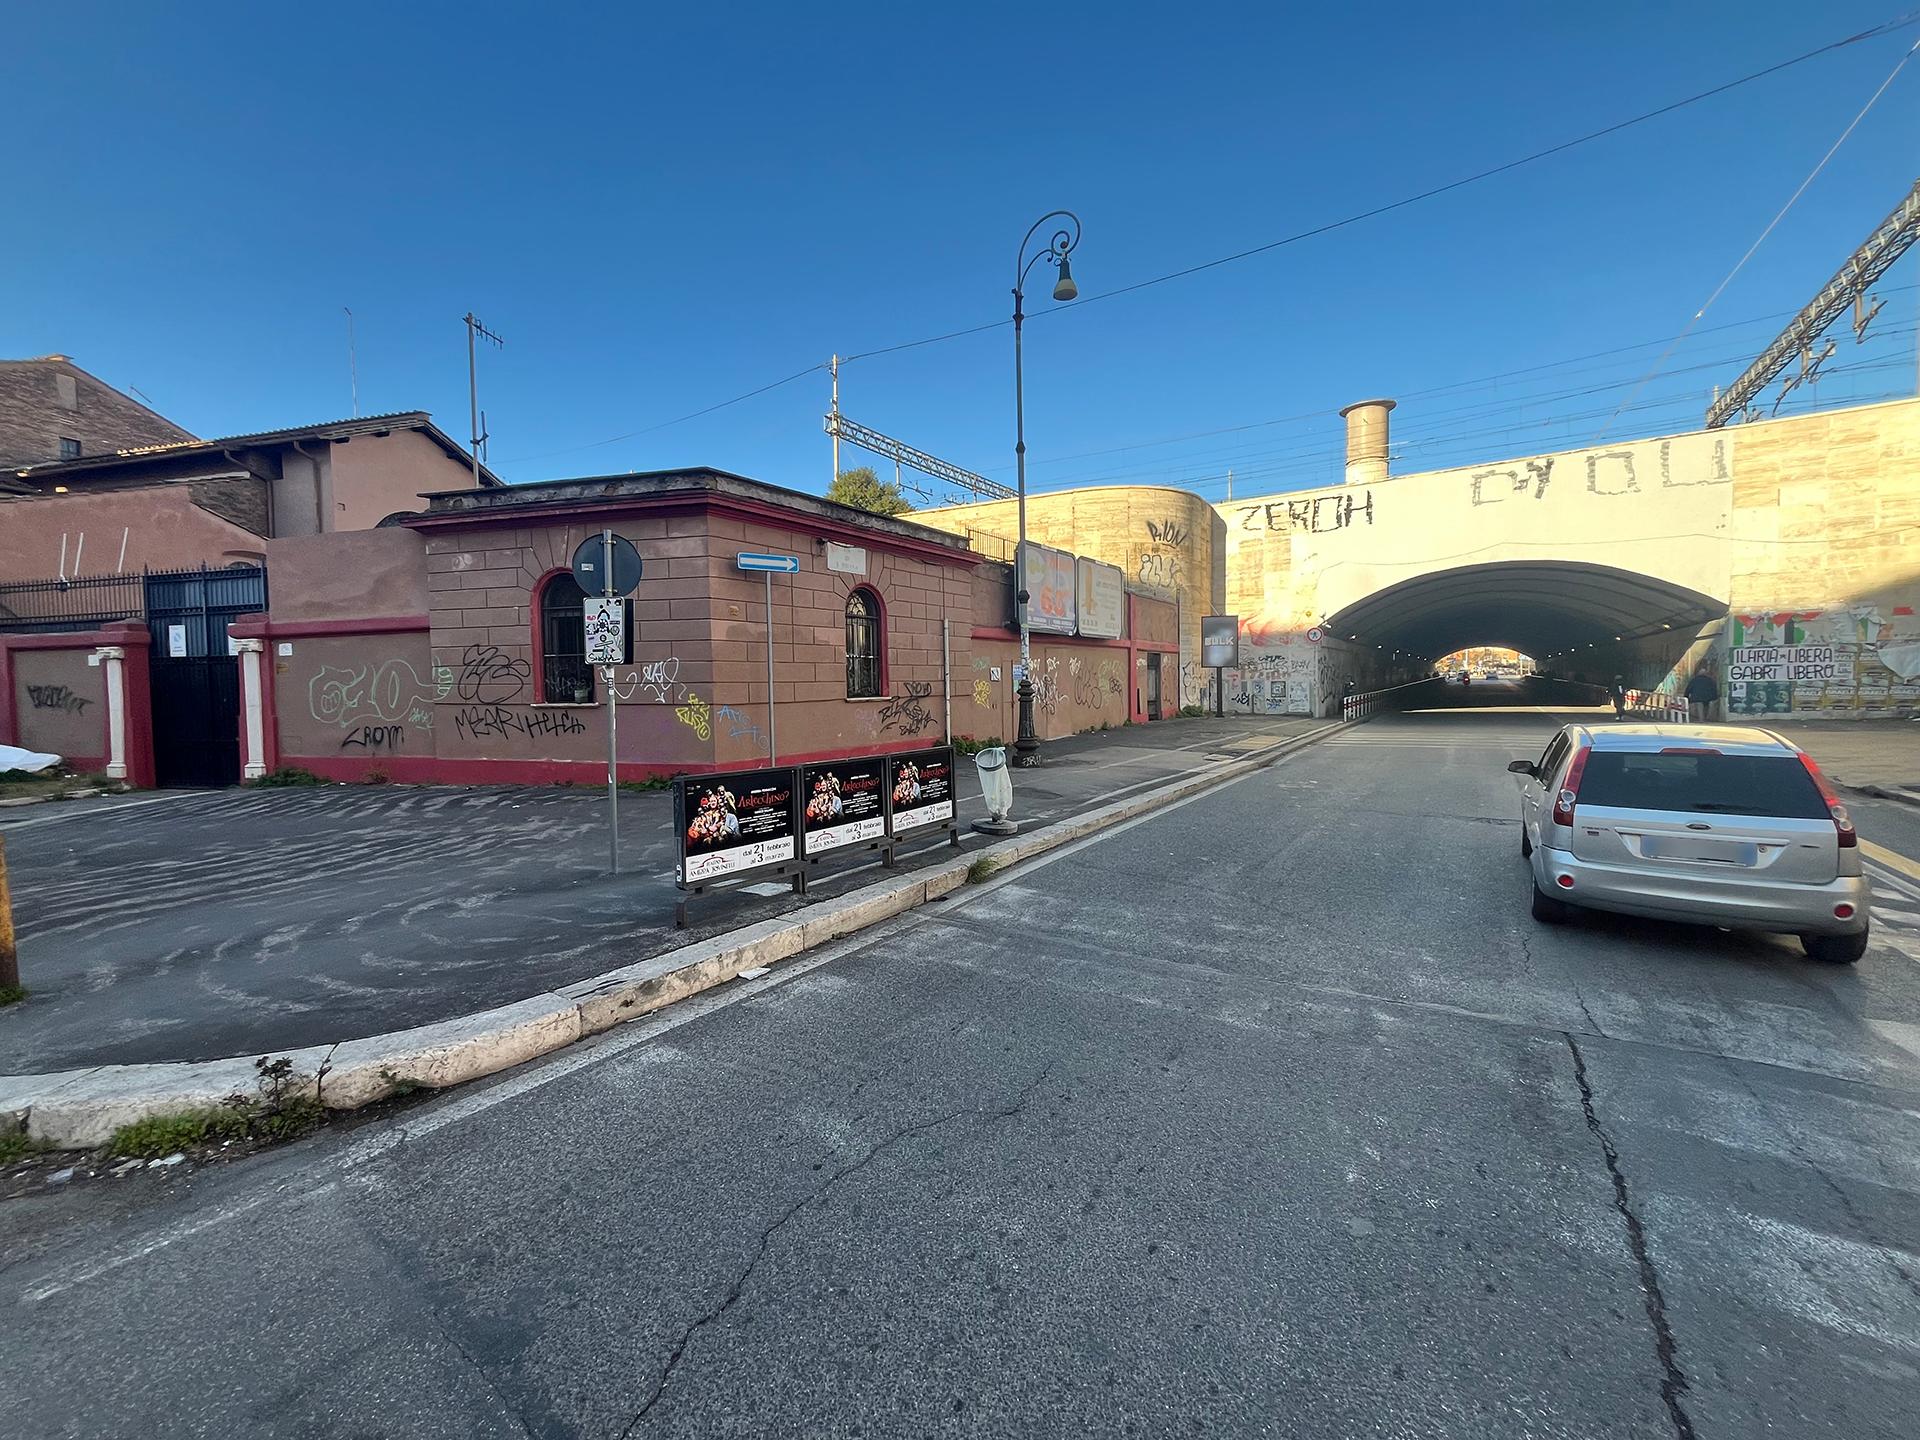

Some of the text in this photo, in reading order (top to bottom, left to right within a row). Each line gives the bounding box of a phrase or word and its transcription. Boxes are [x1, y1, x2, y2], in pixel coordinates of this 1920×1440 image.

[1787, 647, 1833, 663] LIBERA
[1786, 663, 1835, 680] LIBERO
[928, 805, 936, 814] 21
[853, 822, 862, 832] 21
[856, 831, 862, 840] 3
[753, 844, 765, 855] 21
[766, 842, 791, 852] febbraio
[757, 853, 764, 863] 3
[764, 852, 785, 861] marzo
